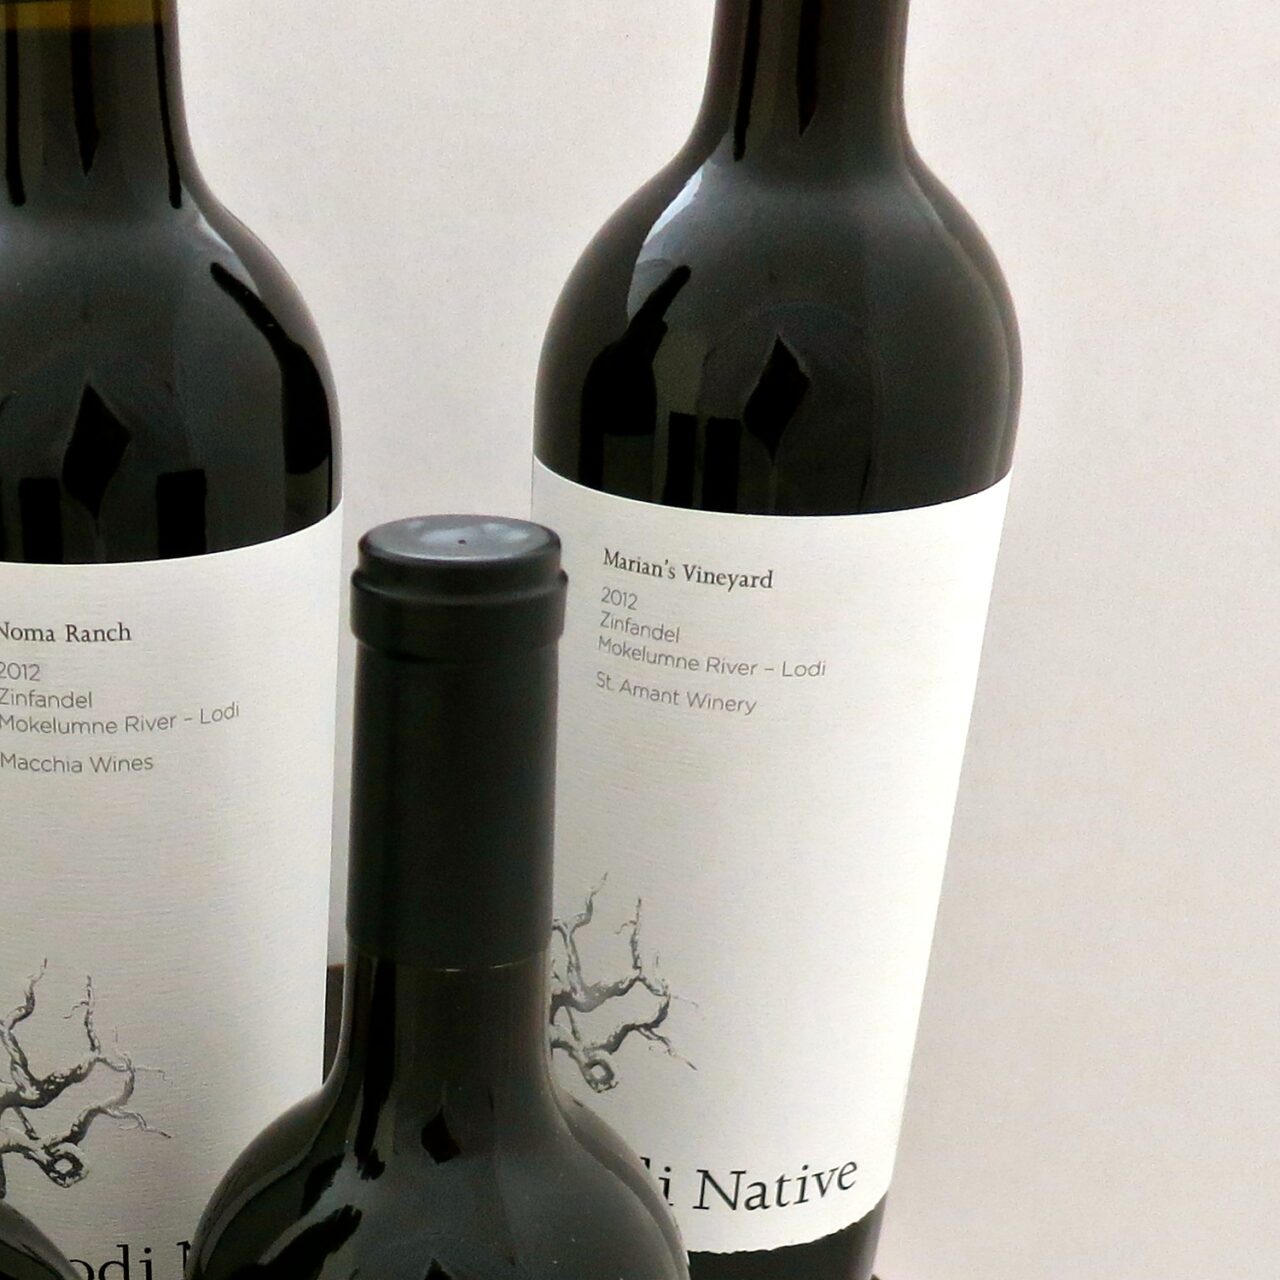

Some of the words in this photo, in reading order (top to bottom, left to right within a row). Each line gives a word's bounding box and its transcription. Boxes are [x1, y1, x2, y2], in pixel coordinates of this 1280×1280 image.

[604, 548, 676, 580] Marian's
[683, 563, 773, 592] Vineyard
[601, 587, 638, 610] 2012
[65, 622, 132, 642] Ranch
[600, 610, 680, 643] Zinfandel
[598, 635, 700, 672] Mokelumne
[706, 656, 758, 676] River
[782, 660, 826, 677] Lodi
[619, 679, 680, 706] Amant
[687, 691, 757, 716] Winery
[125, 714, 176, 732] River
[200, 701, 239, 725] Lodi
[0, 752, 83, 773] Macchia
[90, 755, 154, 773] Wines
[692, 1161, 858, 1211] Native
